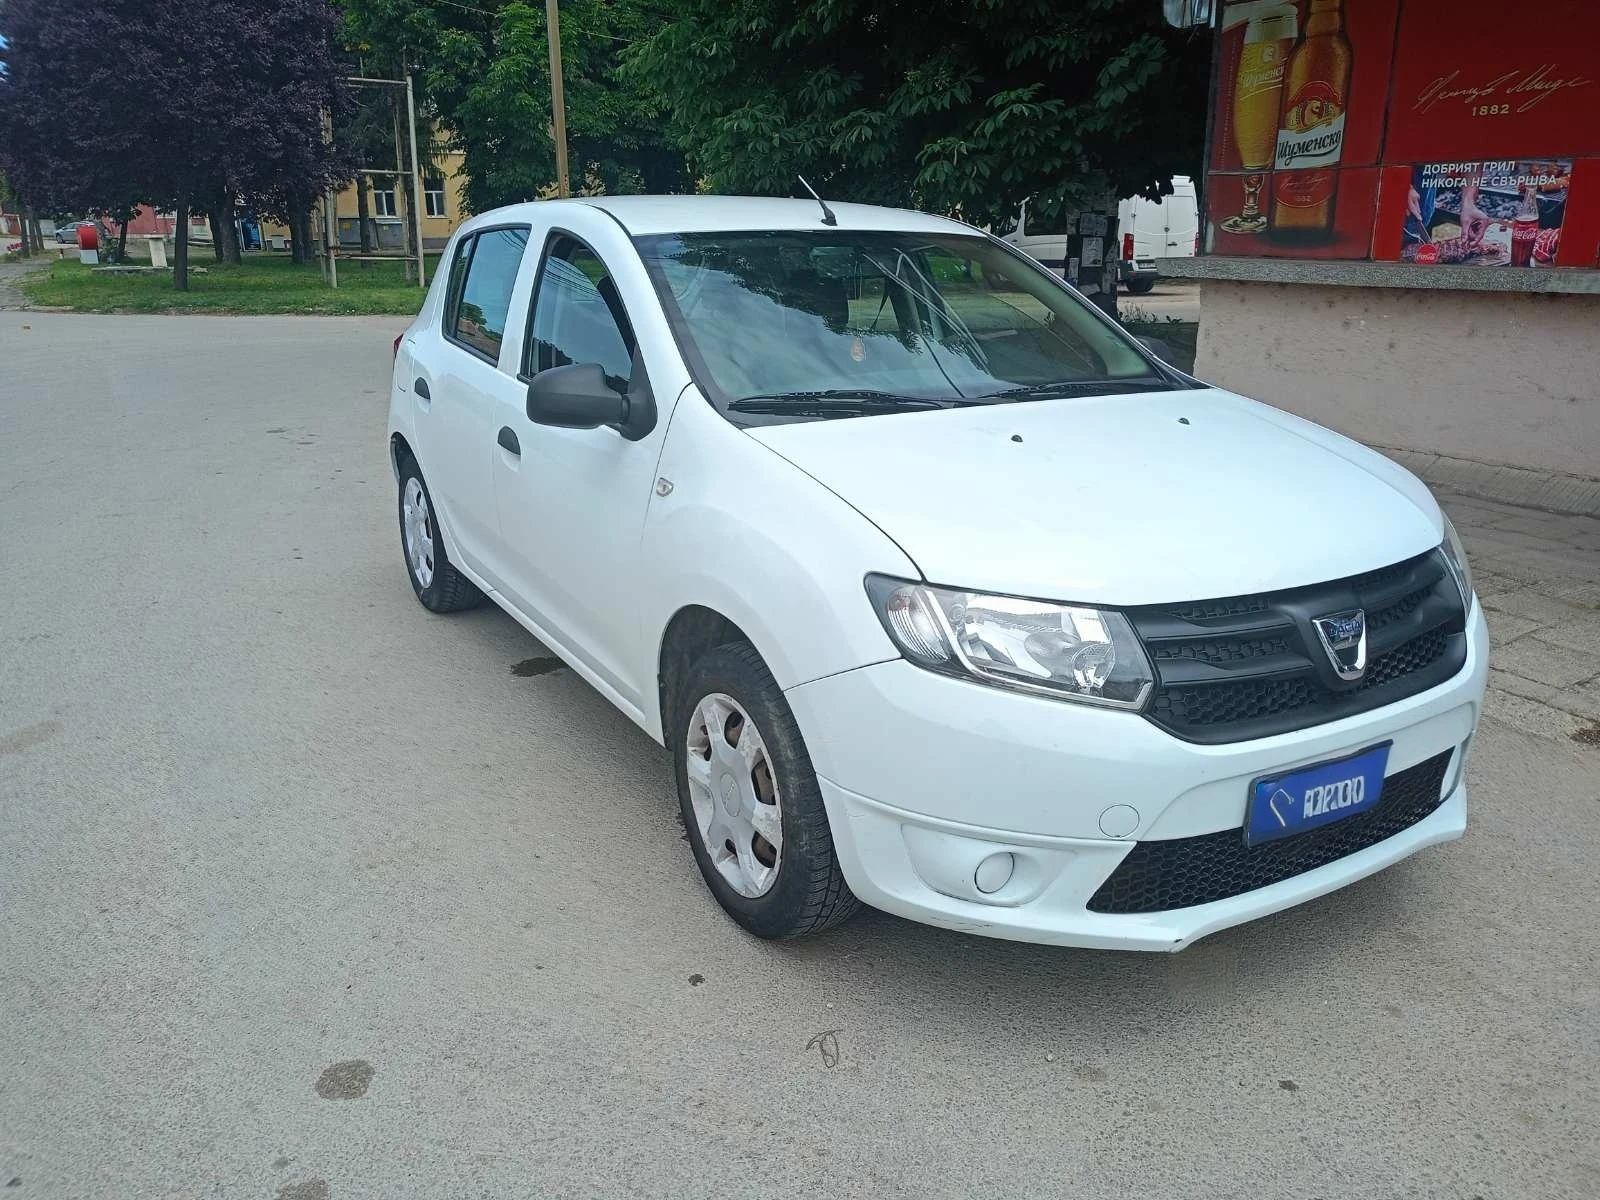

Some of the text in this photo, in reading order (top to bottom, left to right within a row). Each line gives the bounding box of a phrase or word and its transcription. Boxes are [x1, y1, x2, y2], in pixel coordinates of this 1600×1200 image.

[1471, 104, 1510, 117] 1882
[1422, 161, 1515, 176] ДОБРИЯТ ГРИЛ
[1421, 174, 1557, 189] НИКОГА НЕ СВЪРШВА
